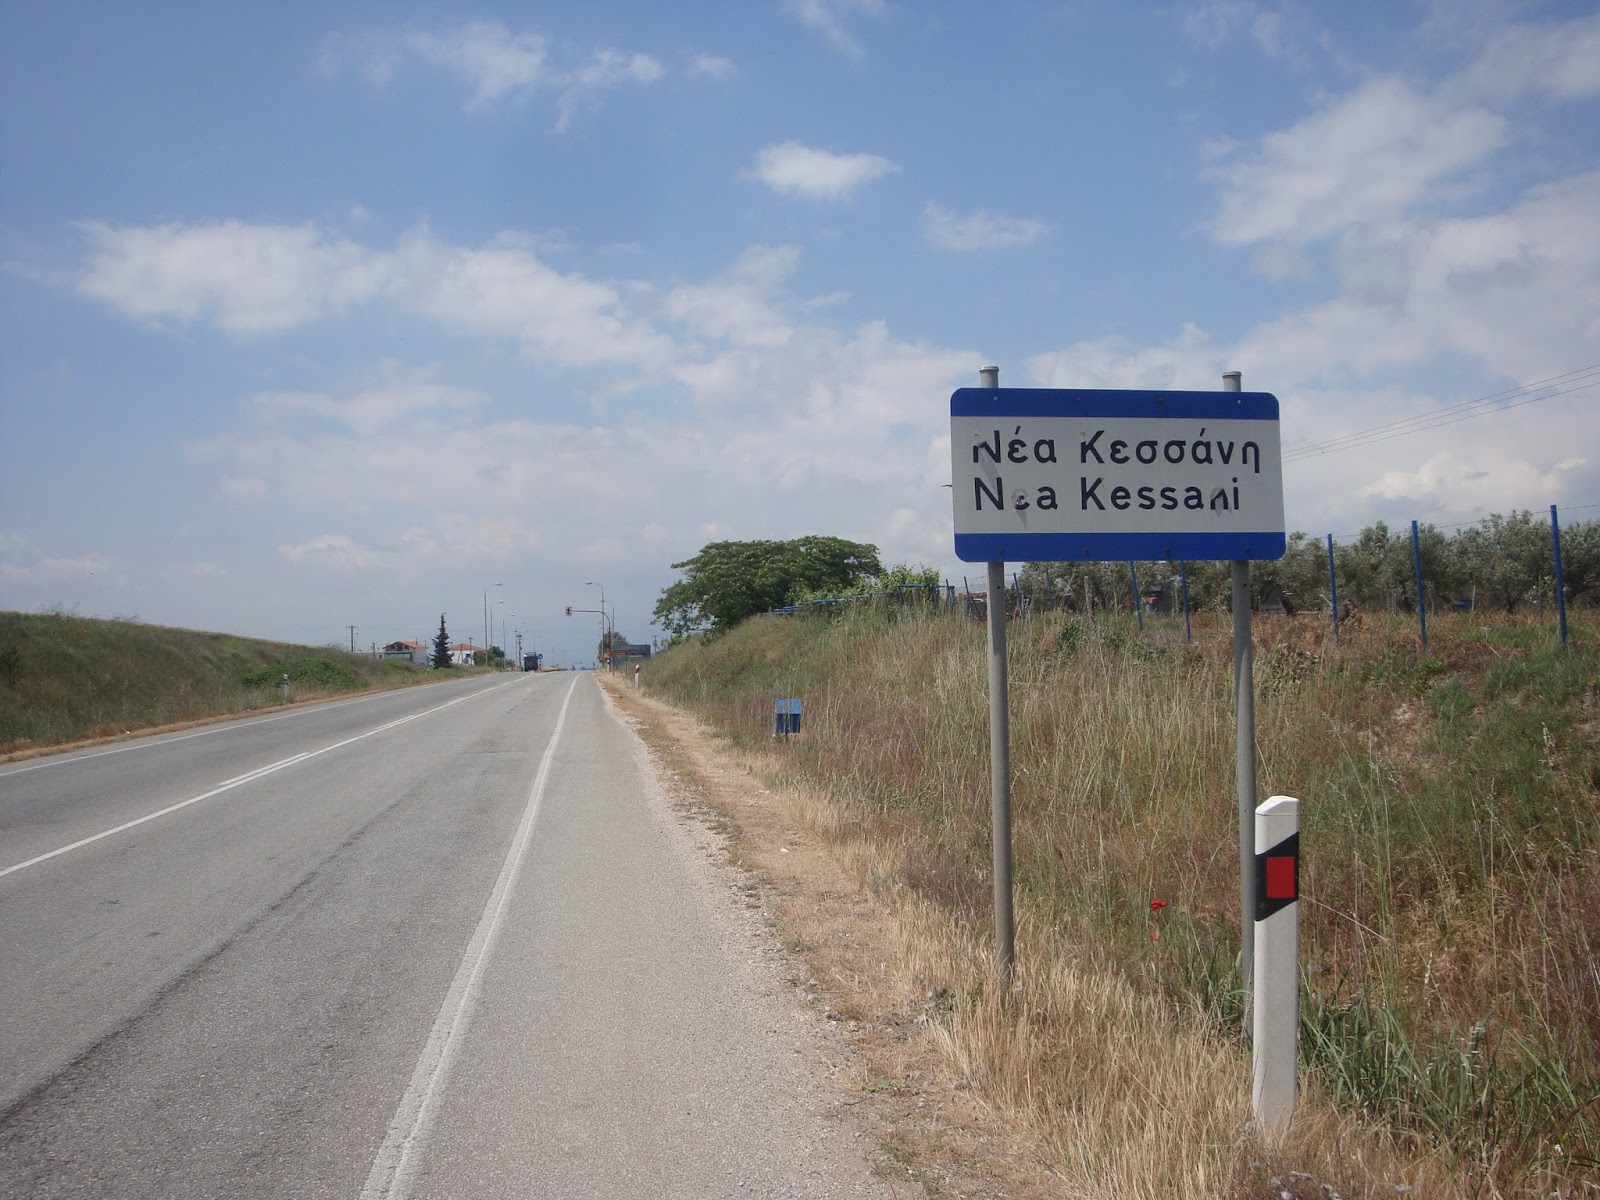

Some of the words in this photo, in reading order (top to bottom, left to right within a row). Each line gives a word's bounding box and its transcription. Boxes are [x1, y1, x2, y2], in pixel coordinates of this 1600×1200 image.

[973, 426, 1057, 464] Νέα
[1080, 428, 1260, 474] Κεσσάνη
[1080, 477, 1240, 511] Kessani
